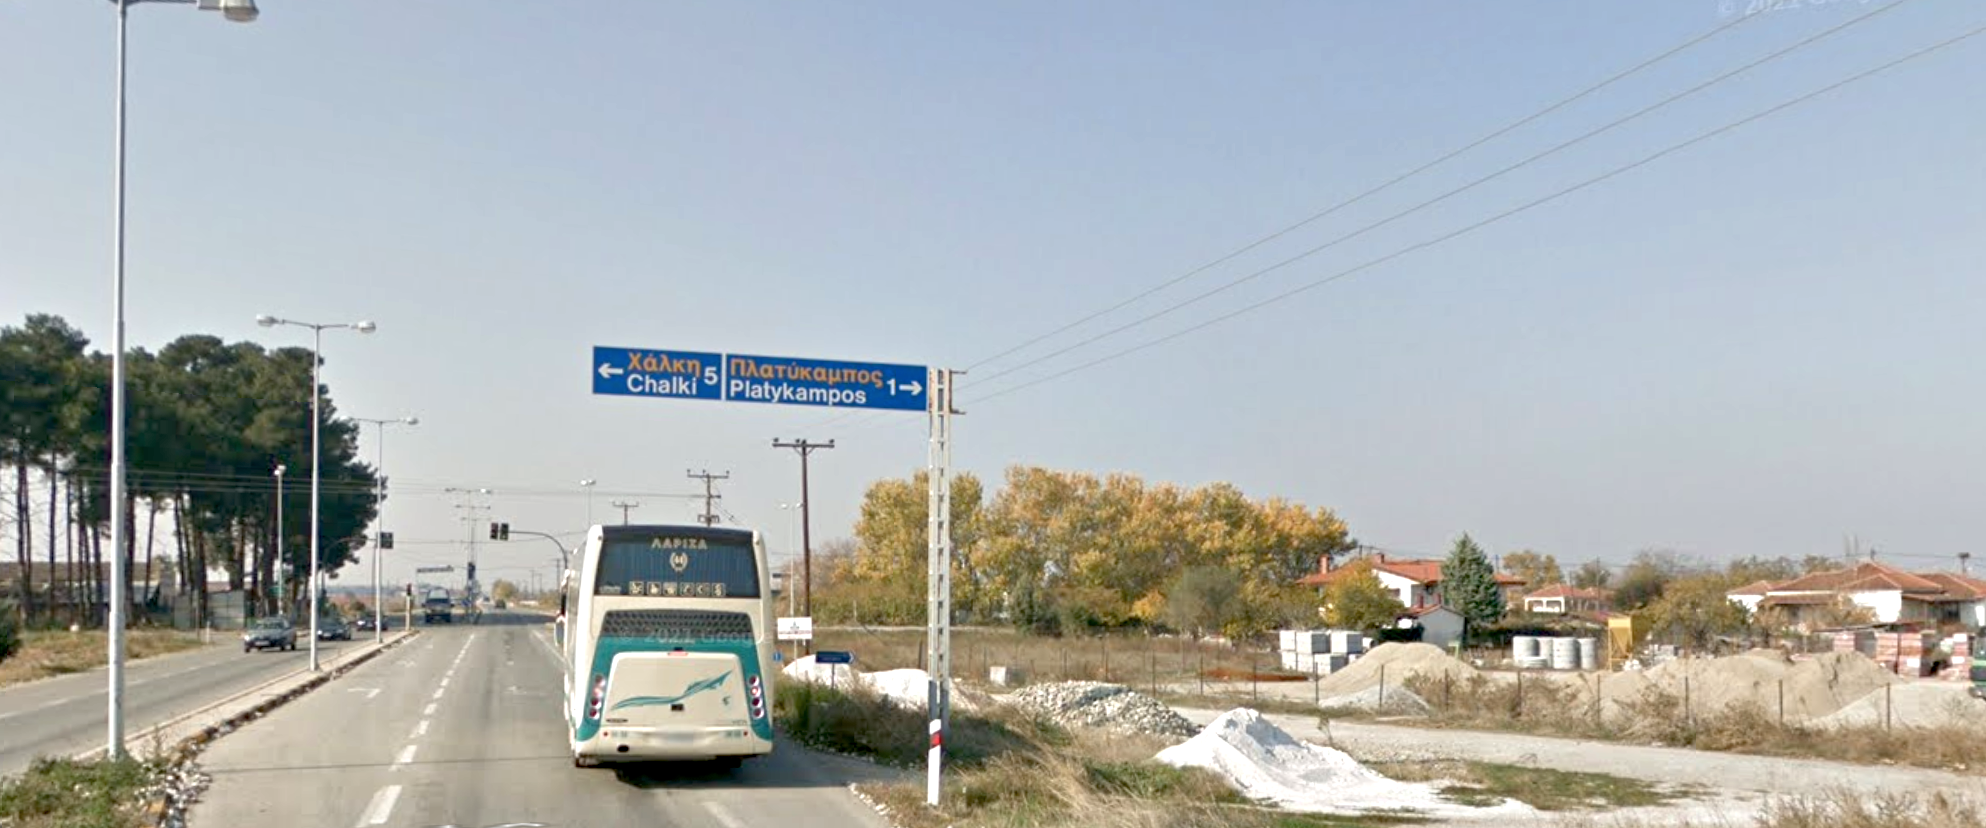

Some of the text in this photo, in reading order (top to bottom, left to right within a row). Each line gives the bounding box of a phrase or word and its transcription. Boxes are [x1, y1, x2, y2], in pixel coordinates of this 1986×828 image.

[628, 351, 701, 377] Χάλκη
[703, 366, 719, 385] 5
[730, 357, 884, 388] Πλατύκαμπος
[626, 373, 698, 395] Chalki
[730, 379, 867, 405] Platykampos
[886, 377, 897, 396] 1
